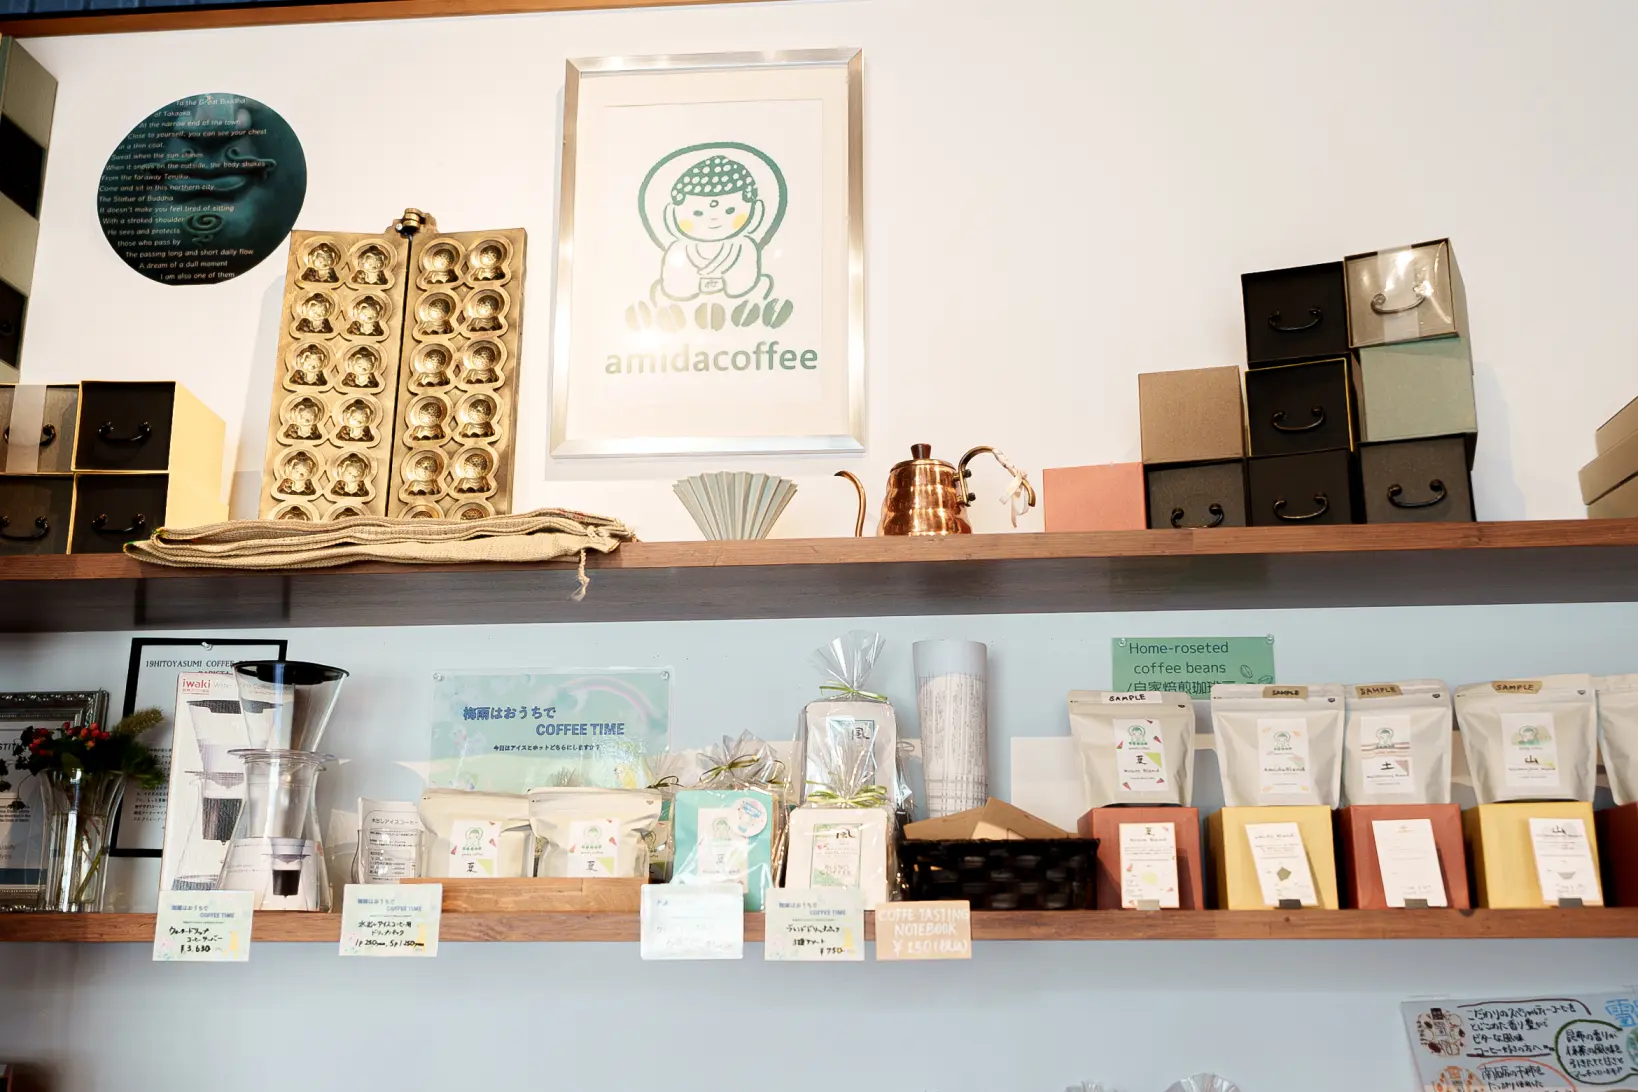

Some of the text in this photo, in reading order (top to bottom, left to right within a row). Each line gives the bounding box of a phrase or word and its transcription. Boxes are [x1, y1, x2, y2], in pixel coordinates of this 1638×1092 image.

[605, 341, 817, 374] amidacoffee
[1129, 641, 1229, 654] Home-roseted
[1134, 662, 1226, 674] coffee beans
[182, 678, 211, 689] iwaki
[1360, 686, 1397, 695] SAMPLE
[1109, 694, 1146, 702] SAMPLE
[463, 706, 556, 720] 梅雨はおうちで
[536, 722, 625, 736] COFFEE TIME
[920, 908, 969, 922] TASTING
[894, 922, 957, 938] NOTEBOOK
